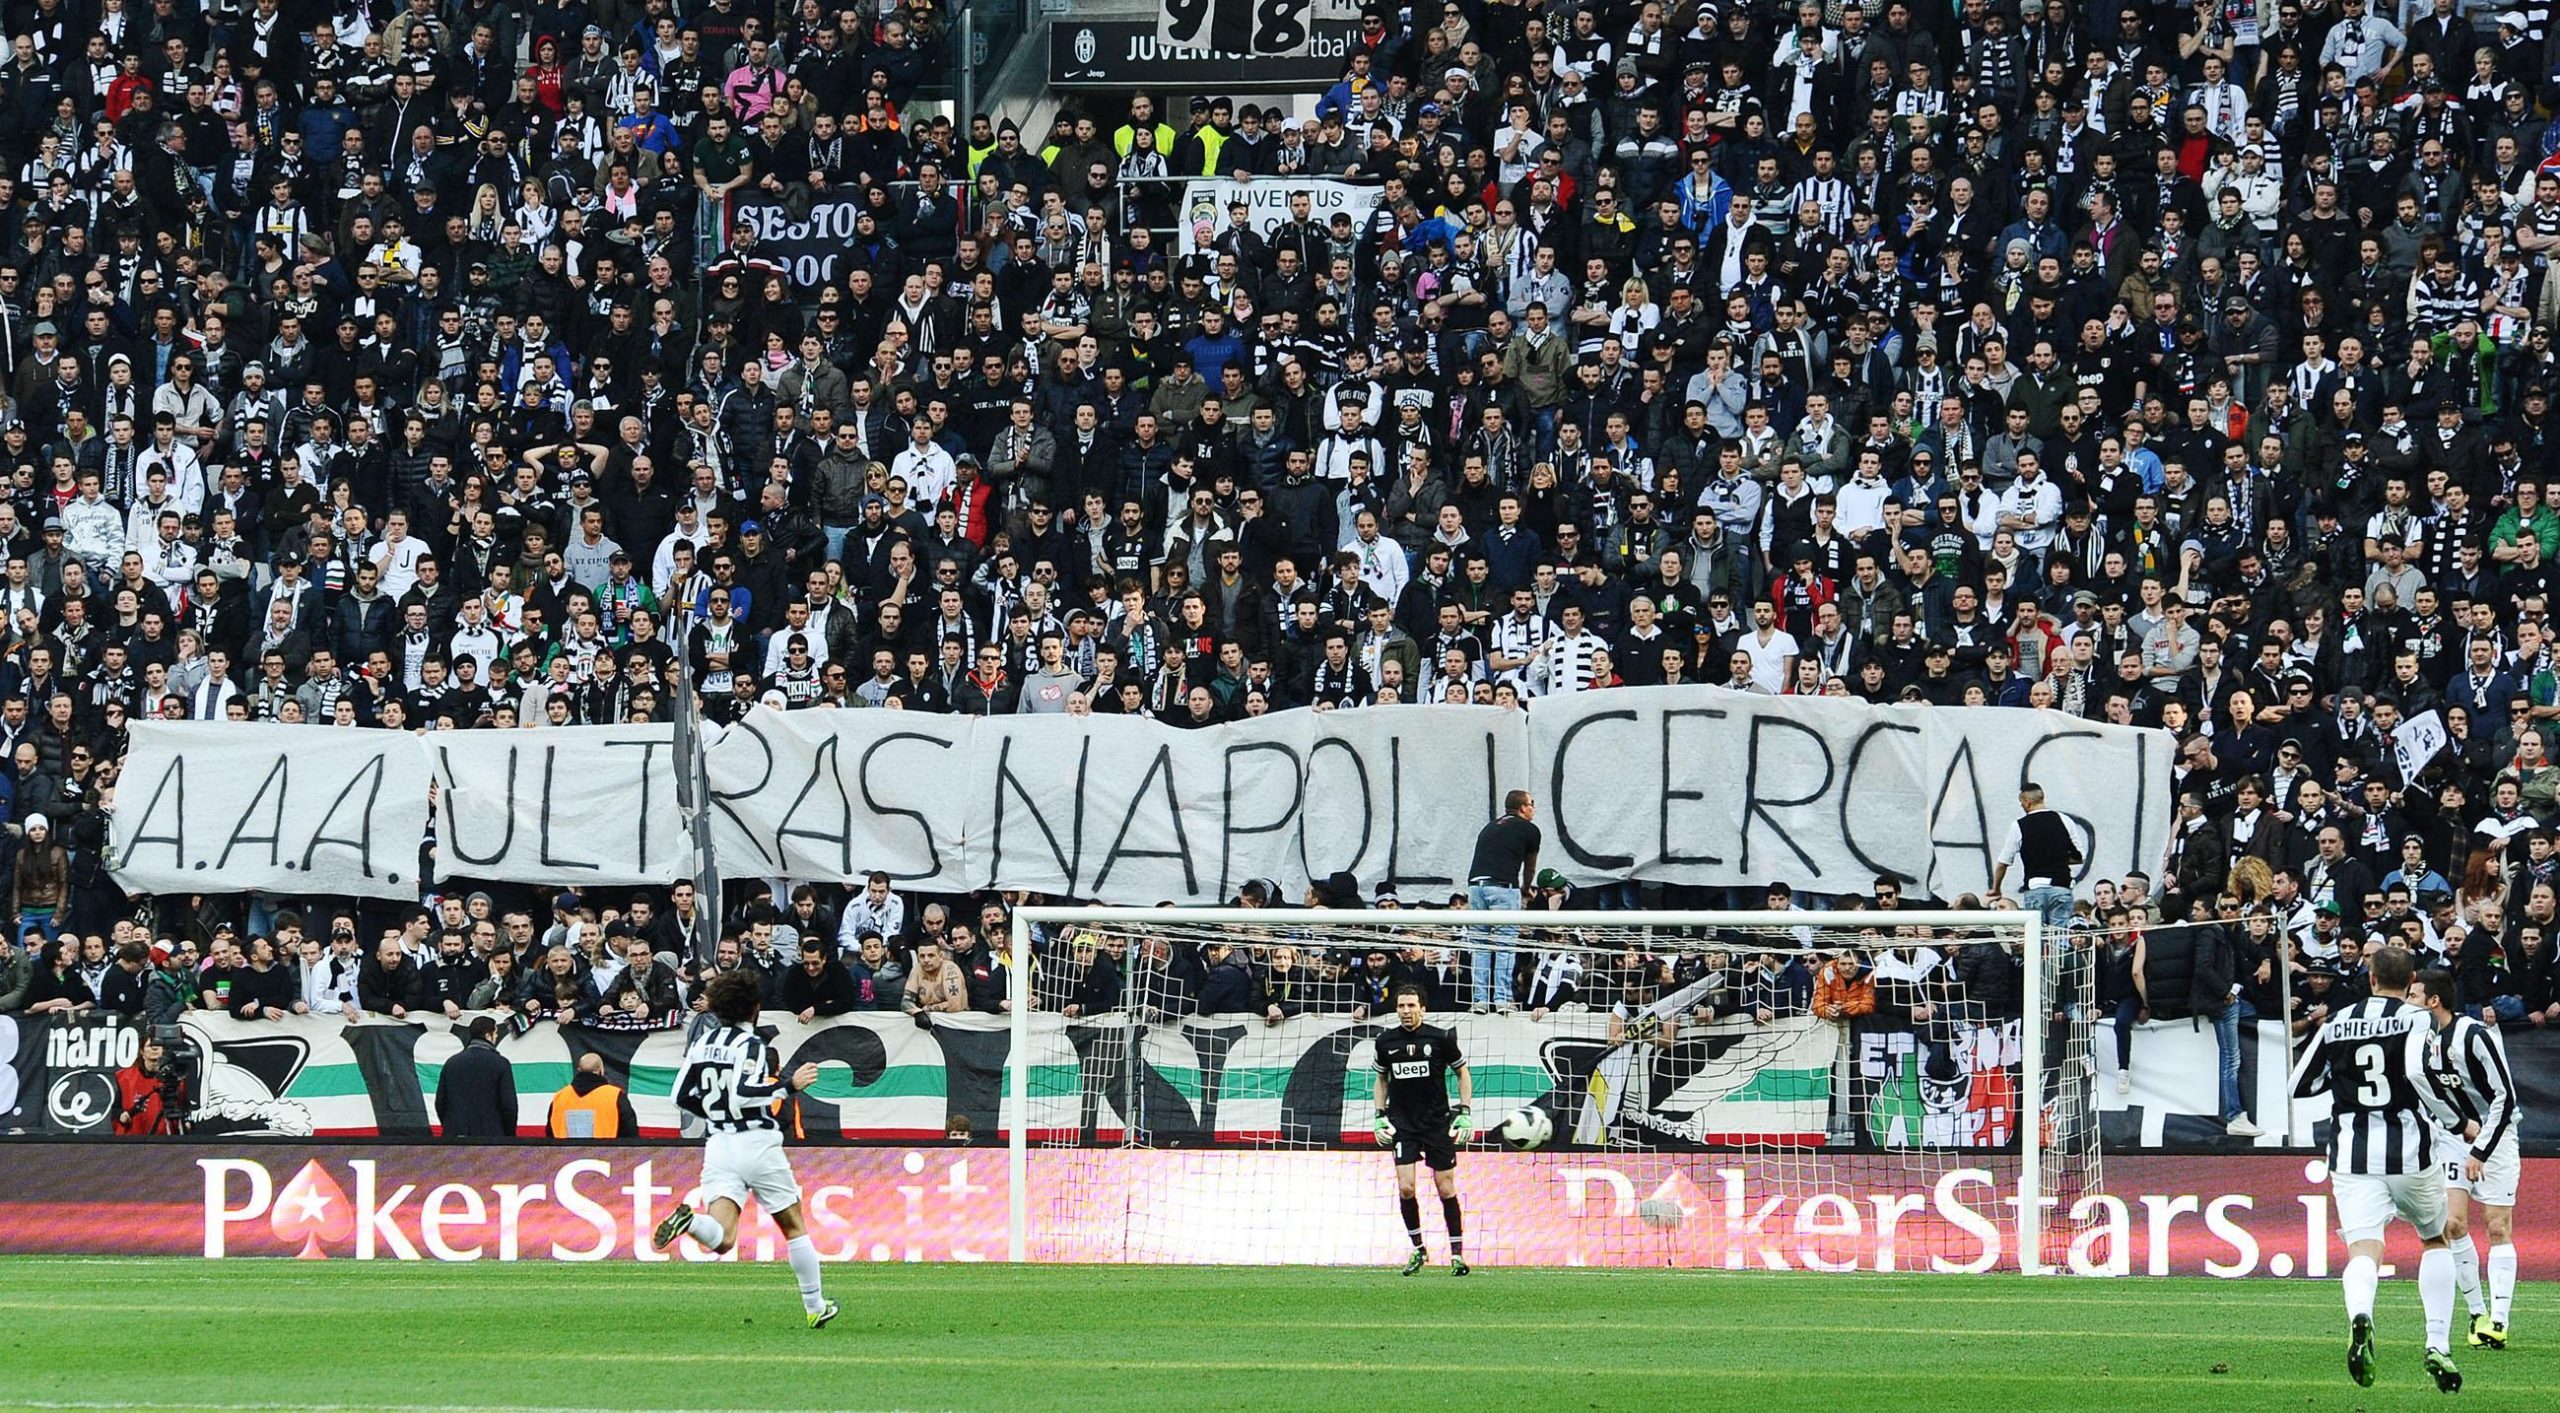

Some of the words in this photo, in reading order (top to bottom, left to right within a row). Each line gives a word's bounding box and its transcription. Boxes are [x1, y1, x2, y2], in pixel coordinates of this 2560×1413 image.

[2076, 373, 2103, 385] Jeep
[438, 719, 953, 881] ULTRAS
[989, 732, 1498, 905] NAPOLI
[1551, 709, 2148, 898] CERCASI
[46, 1015, 140, 1068] nario
[701, 1067, 744, 1120] 21
[1394, 1063, 1428, 1078] Jeep
[2354, 1043, 2392, 1107] 3
